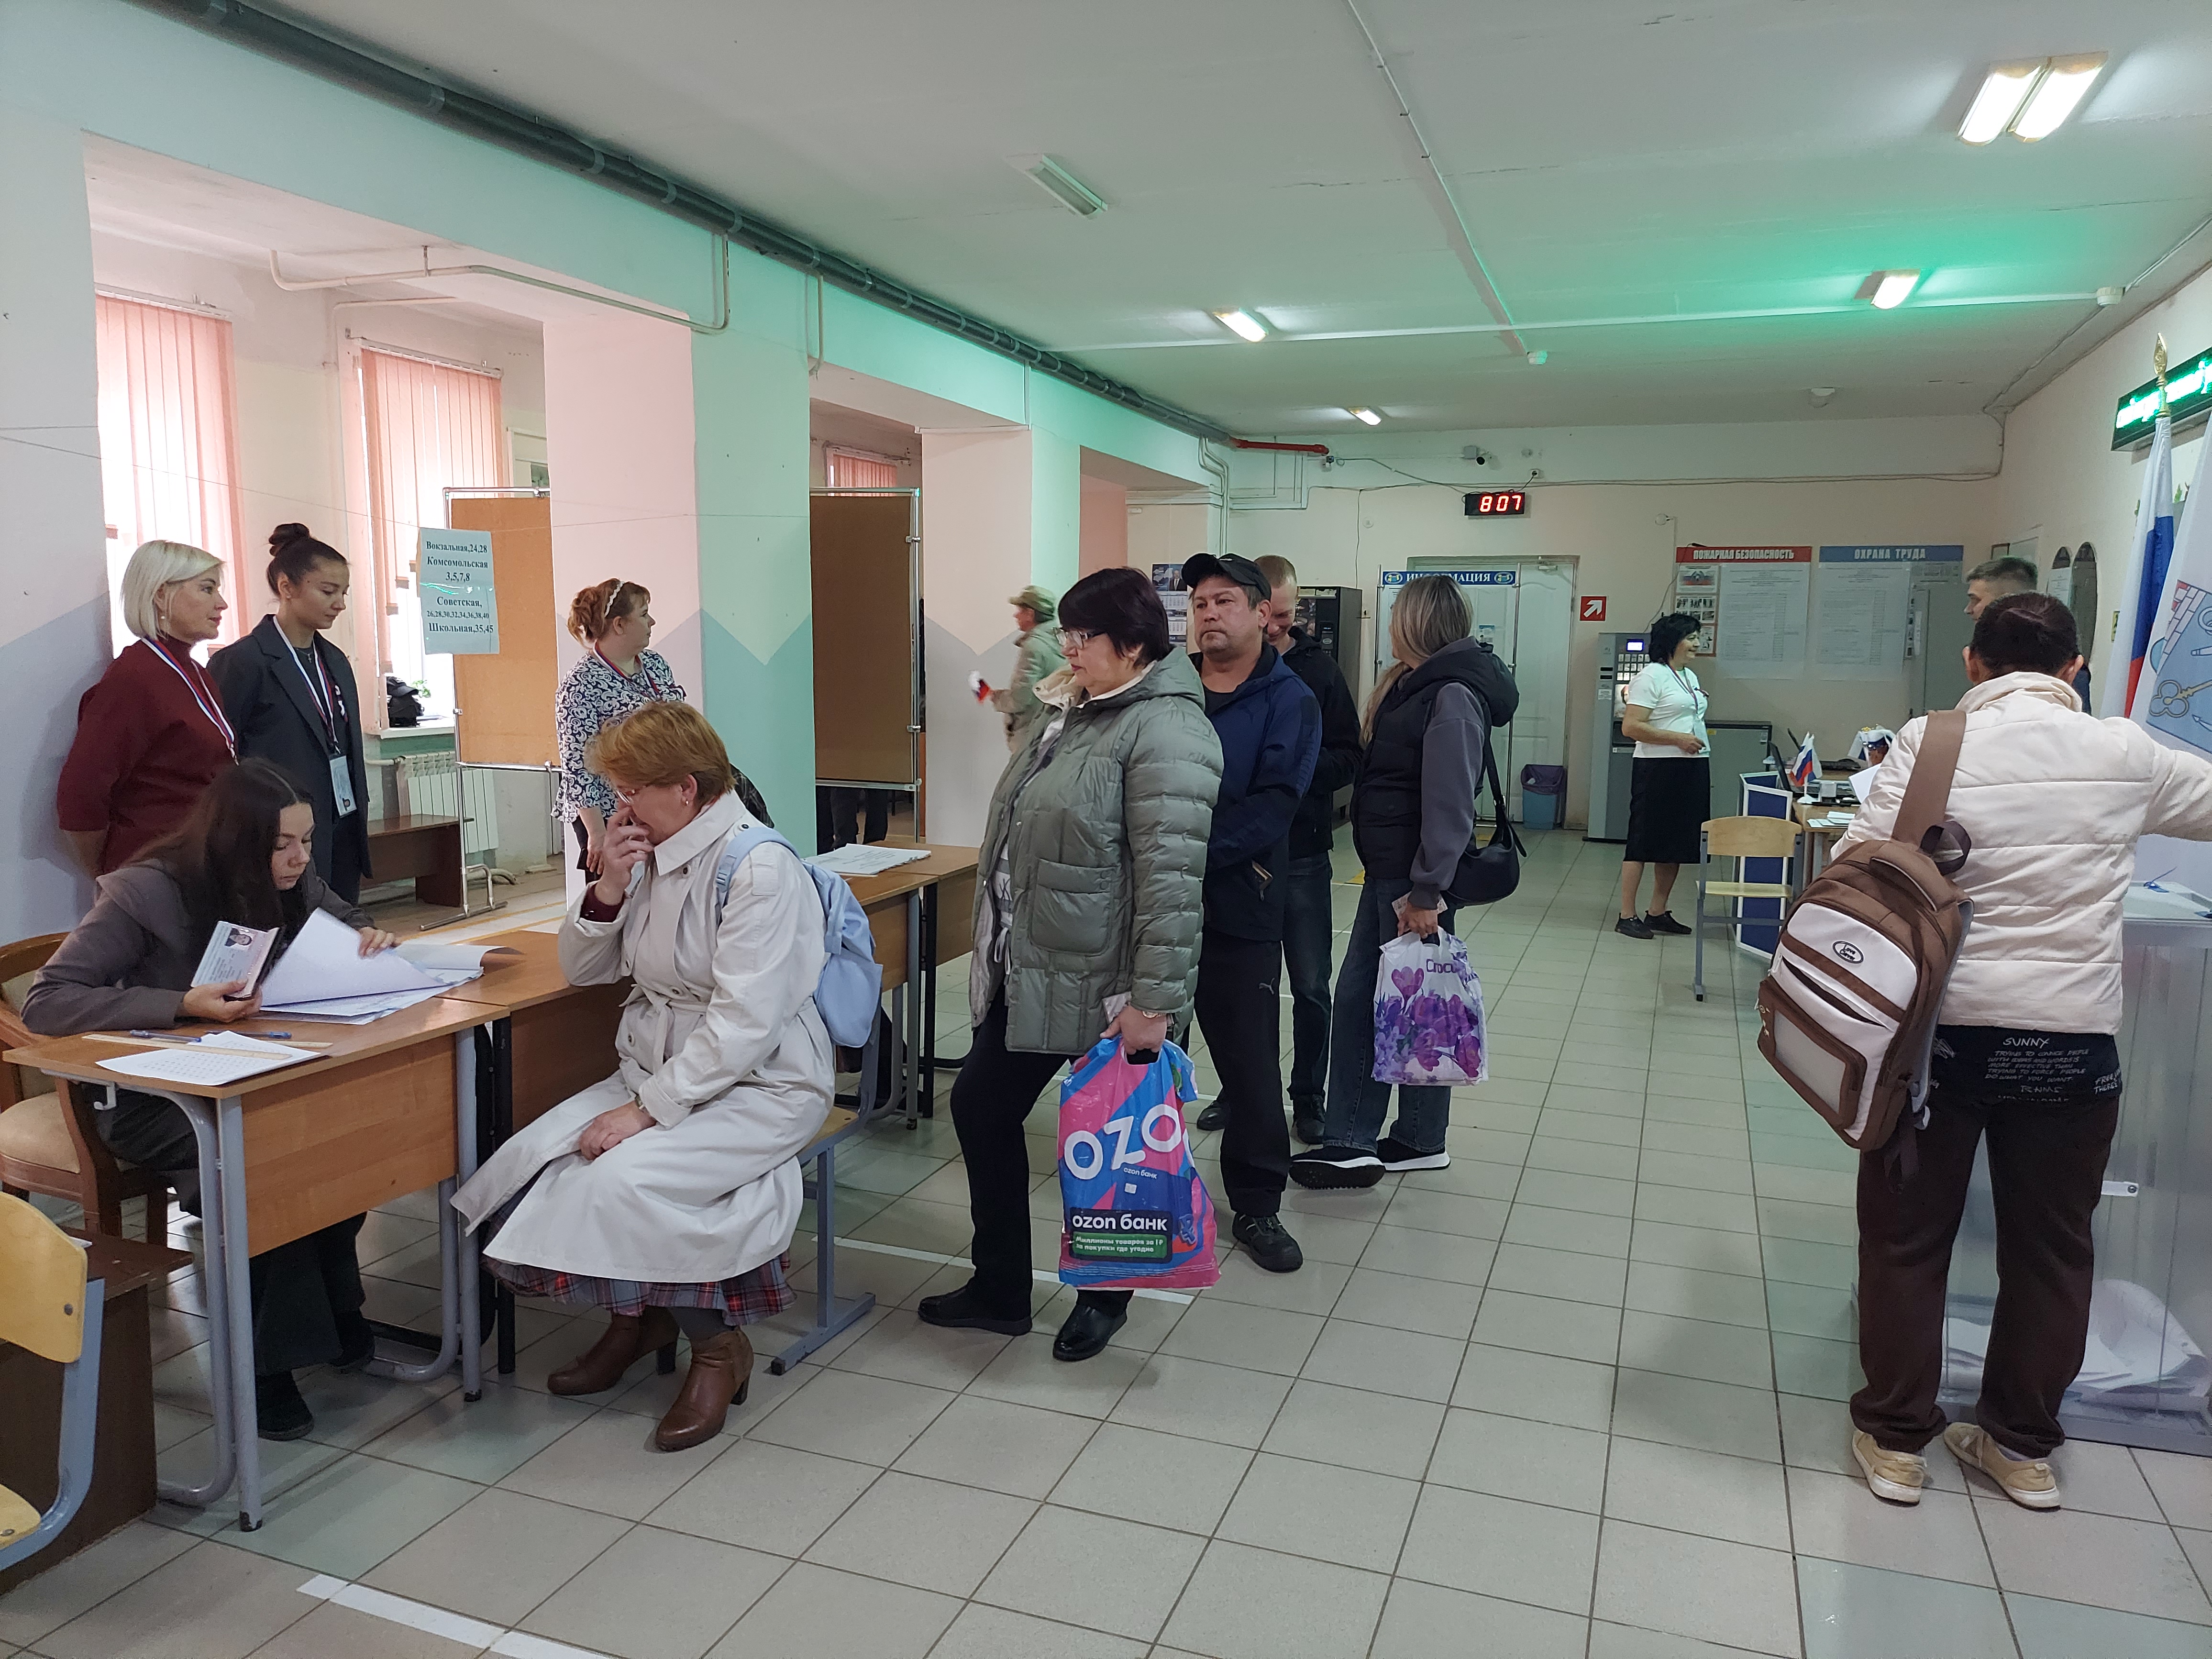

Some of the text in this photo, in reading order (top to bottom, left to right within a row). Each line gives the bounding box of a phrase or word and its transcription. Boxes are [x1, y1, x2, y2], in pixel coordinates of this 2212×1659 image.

[1693, 549, 1794, 560] ПОЖАРНАЯ БЕЗОПАСНОСТЬ
[1854, 548, 1926, 560] ОХРАНА ТРУДА
[427, 556, 488, 568] Комсомольская
[1406, 573, 1491, 583] ИНМАЦИЯ
[2003, 1037, 2050, 1049] SUNNY
[1123, 1167, 1158, 1179] ozon банк
[1072, 1213, 1168, 1231] ozon банк
[1075, 1236, 1114, 1244] Миллионы
